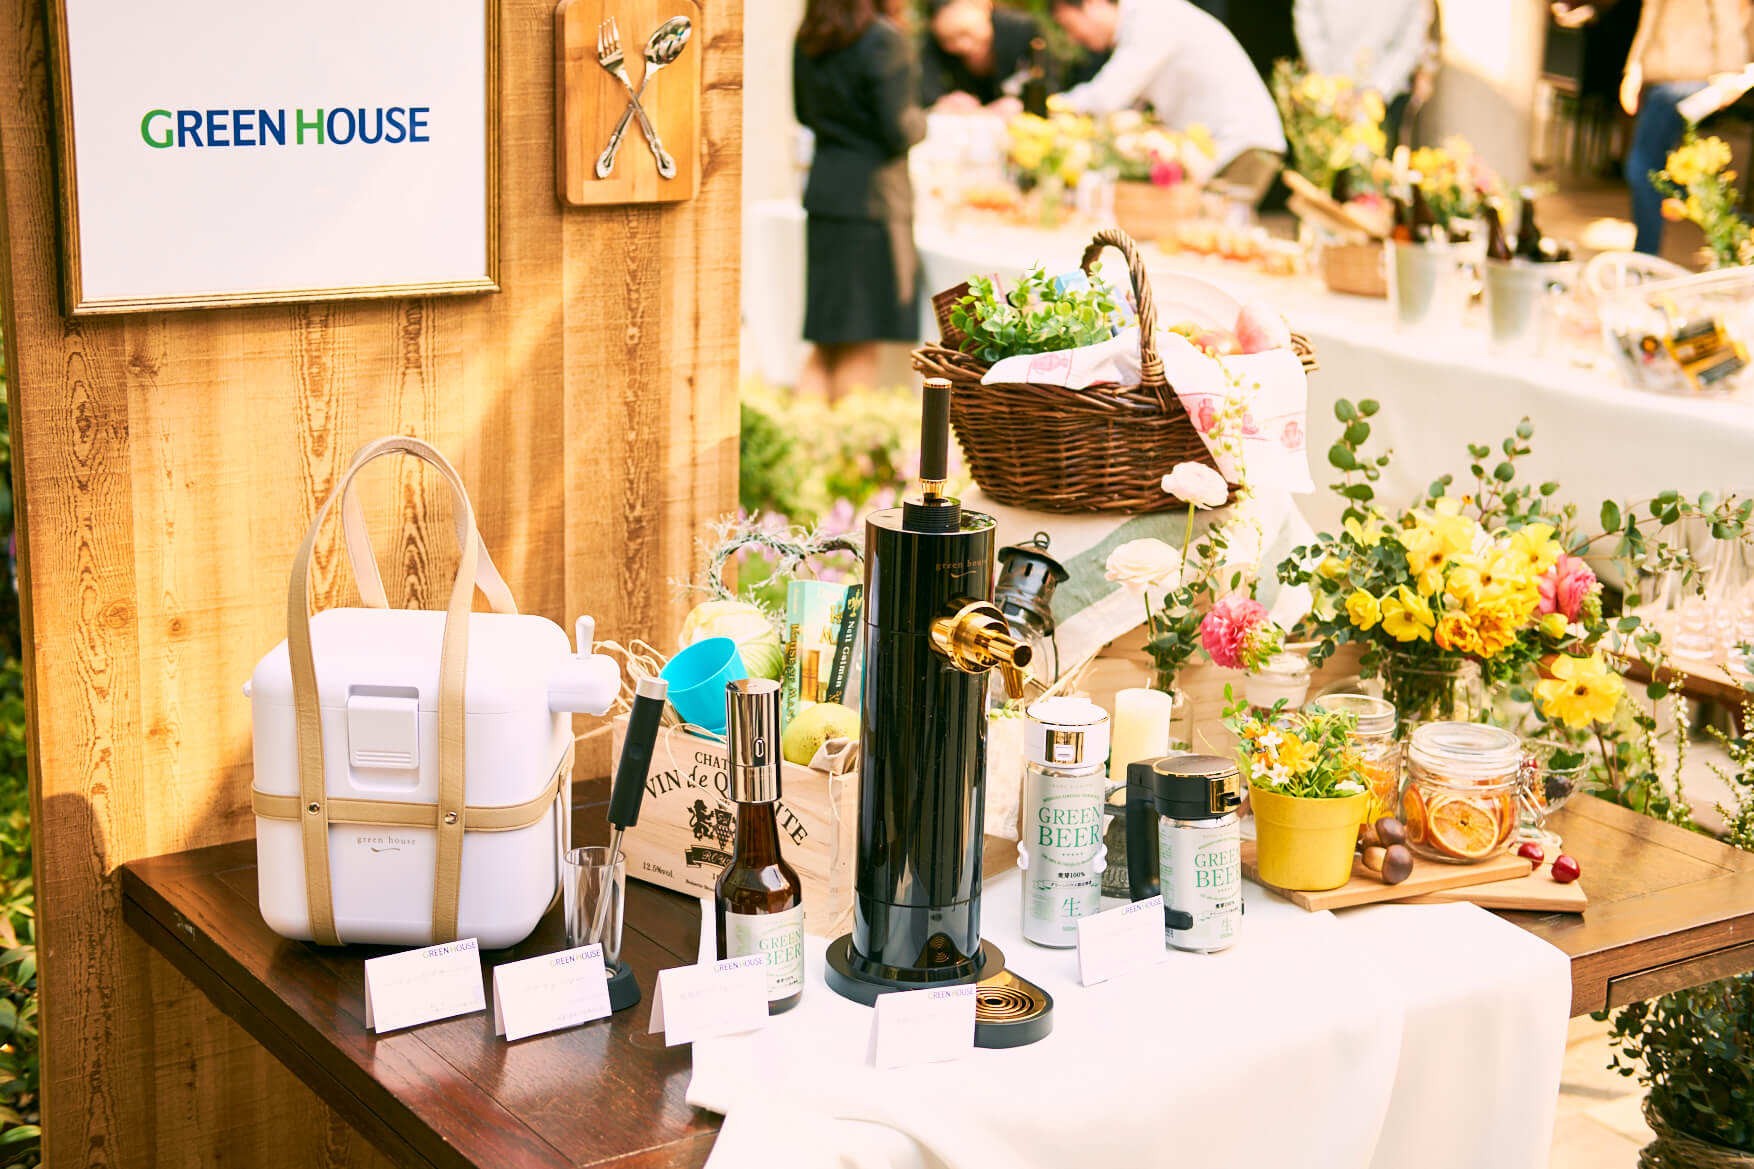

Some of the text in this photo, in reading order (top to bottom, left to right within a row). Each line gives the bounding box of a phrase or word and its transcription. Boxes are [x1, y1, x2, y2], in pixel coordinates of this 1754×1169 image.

[141, 107, 430, 148] GREEN HOUSE
[835, 646, 851, 688] Gaiman
[695, 751, 729, 770] CHAT
[645, 770, 681, 798] VIN
[687, 765, 708, 788] de
[1038, 806, 1101, 825] GREEN
[356, 834, 417, 846] green house
[1038, 823, 1100, 848] BEER
[1061, 896, 1081, 917] 生
[759, 928, 801, 951] GREEN
[423, 941, 477, 959] GREEN HOUSE
[551, 950, 601, 967] GREEN HOUSE
[713, 957, 763, 973] GREEN HOUSE
